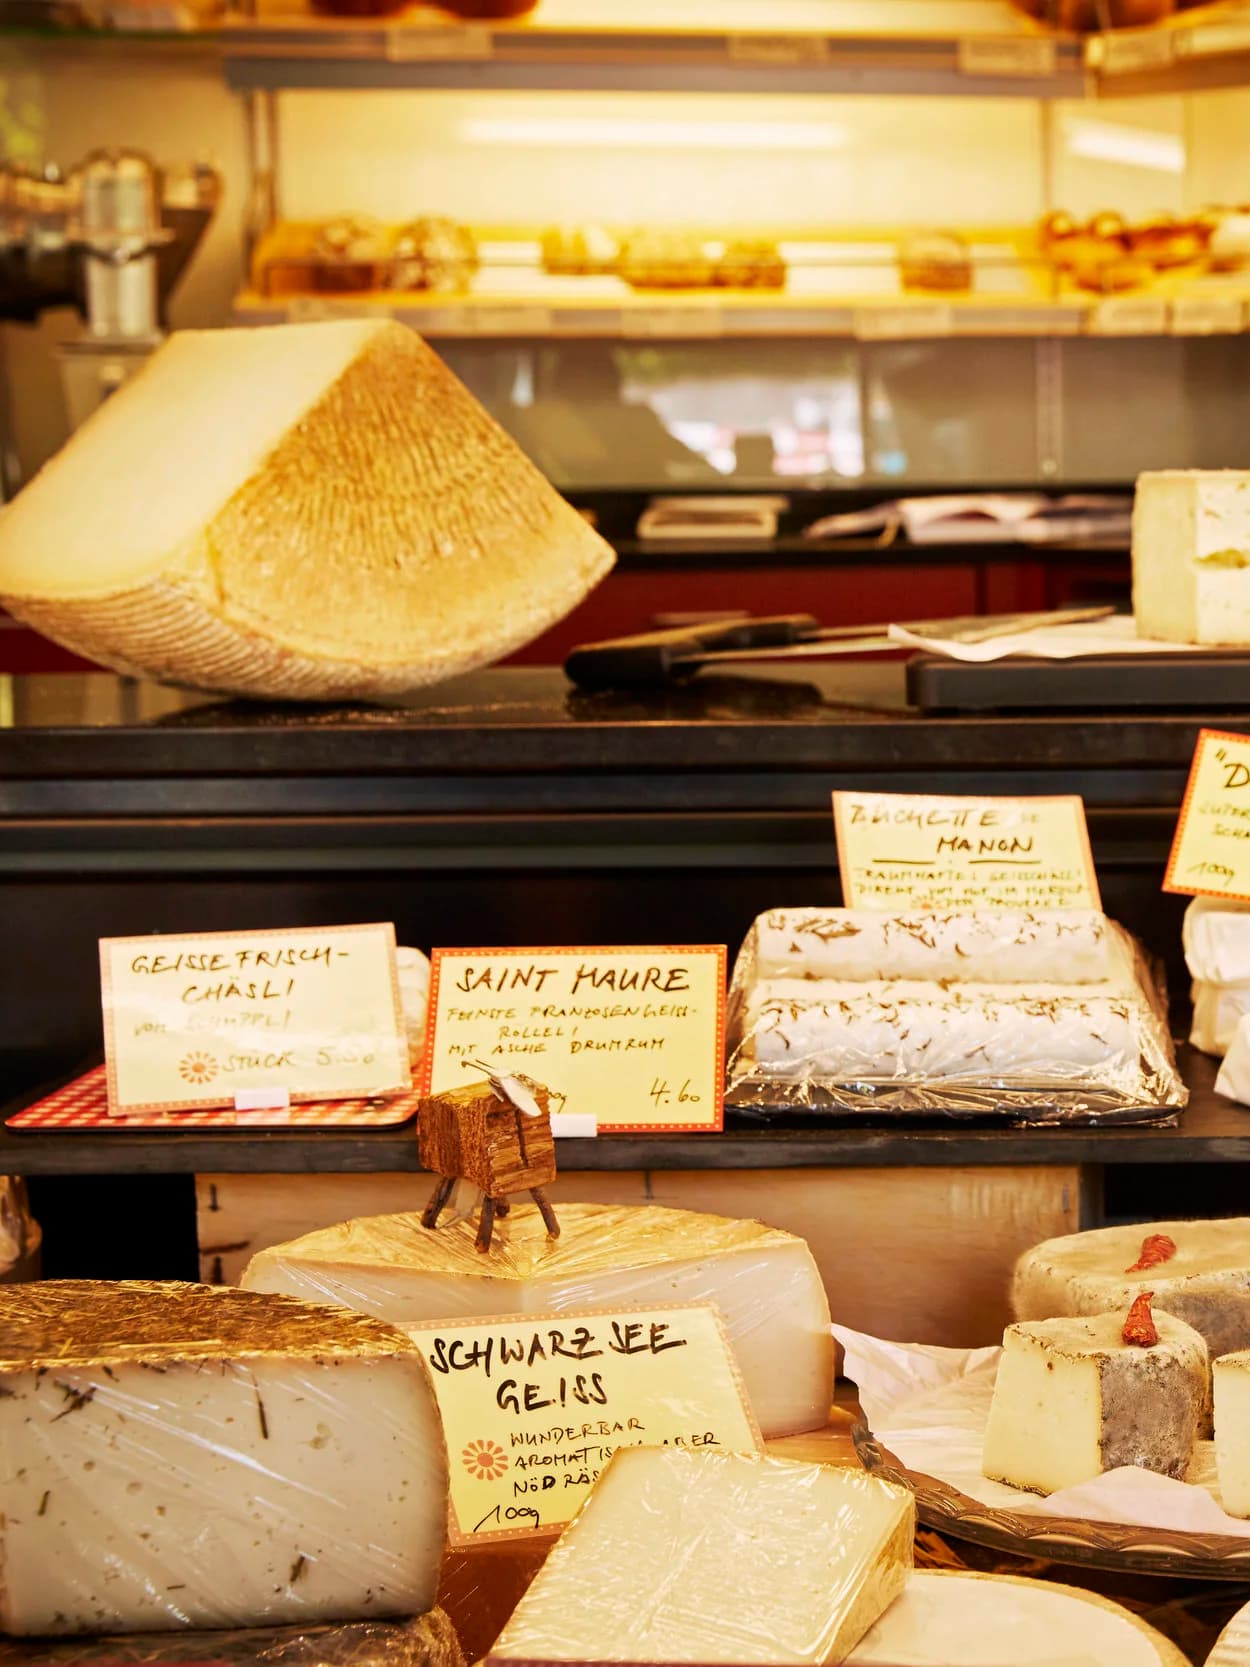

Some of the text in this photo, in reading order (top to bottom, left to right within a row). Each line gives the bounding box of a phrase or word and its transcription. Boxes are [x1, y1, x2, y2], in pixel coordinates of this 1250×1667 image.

[936, 835, 1033, 854] MANON
[181, 976, 295, 1005] CHÄSLI
[456, 963, 690, 994] SAINT MAURE
[448, 1044, 477, 1056] MIT
[491, 1043, 547, 1055] ASCHE
[650, 1077, 701, 1107] 4.60
[496, 1372, 608, 1414] GEISS
[510, 1417, 646, 1447] WUNDERBAR
[513, 1475, 556, 1497] NÖD
[473, 1505, 540, 1532] 100g
